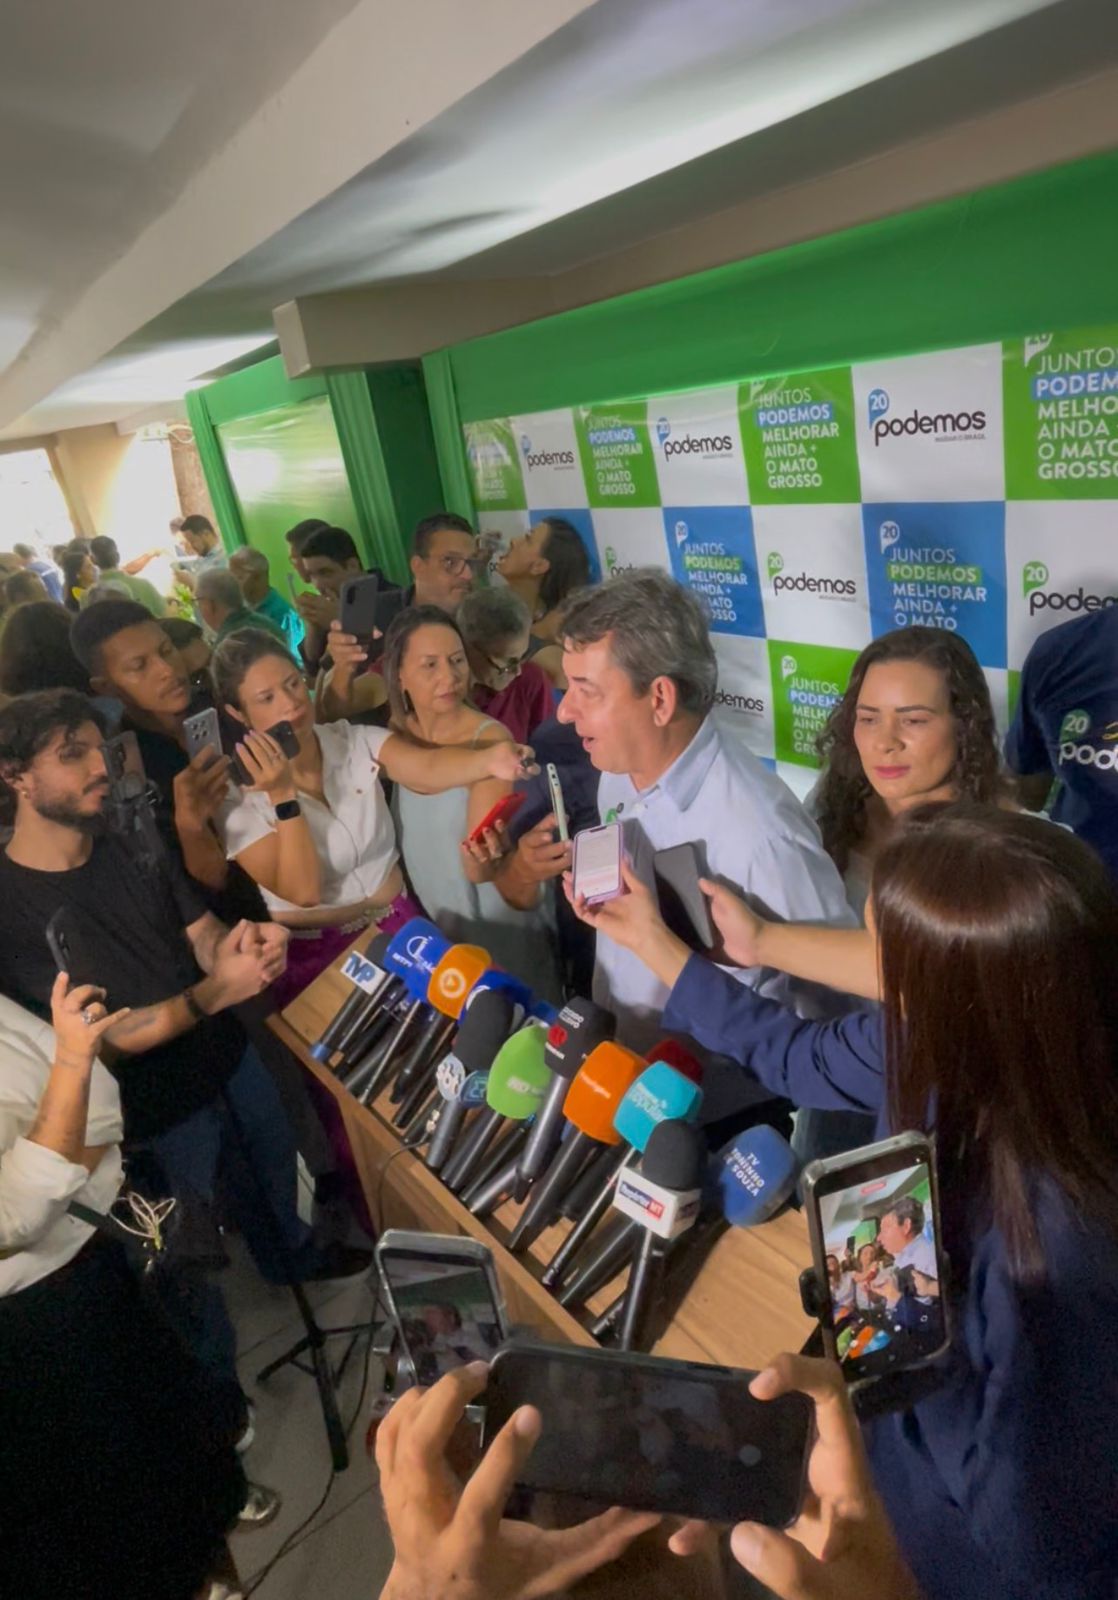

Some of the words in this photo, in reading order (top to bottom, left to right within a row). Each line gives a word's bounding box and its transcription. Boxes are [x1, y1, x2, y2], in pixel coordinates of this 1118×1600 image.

[1036, 346, 1118, 375] JUNTO
[758, 387, 813, 409] JUNTOS
[870, 393, 888, 411] 20
[758, 404, 830, 426] PODEMOS
[588, 427, 636, 444] PODEMOS
[762, 422, 840, 443] MELHORAR
[874, 409, 986, 447] podemos
[1037, 418, 1110, 441] AINDA
[593, 442, 644, 459] MELHORAR
[663, 433, 733, 462] podemos
[764, 443, 807, 459] AINDA
[1038, 442, 1055, 460] O
[527, 450, 575, 472] podemos
[766, 460, 776, 474] O
[779, 457, 818, 473] MATO
[597, 471, 605, 483] O
[606, 470, 632, 483] MATO
[767, 473, 822, 489] GROSSO
[599, 482, 636, 496] GROSSO
[882, 525, 898, 539] 20
[684, 542, 726, 556] JUNTOS
[890, 547, 956, 564] JUNTOS
[685, 555, 741, 571] PODEMOS
[688, 570, 749, 586] MELHORAR
[890, 564, 977, 583] PODEMOS
[1026, 566, 1046, 582] 20
[773, 571, 857, 597] podemos
[893, 582, 987, 602] MELHORAR
[708, 596, 733, 609] ATO
[894, 598, 946, 614] AINDA
[894, 612, 908, 627] O
[911, 613, 957, 631] MATO
[791, 676, 840, 695] JUNTOS
[714, 688, 764, 712] demos
[790, 689, 842, 708] PODEM
[793, 717, 826, 732] AIND
[1063, 713, 1089, 734] 20
[793, 728, 803, 740] O
[747, 1152, 761, 1166] TV
[732, 1164, 760, 1197] SOUZA
